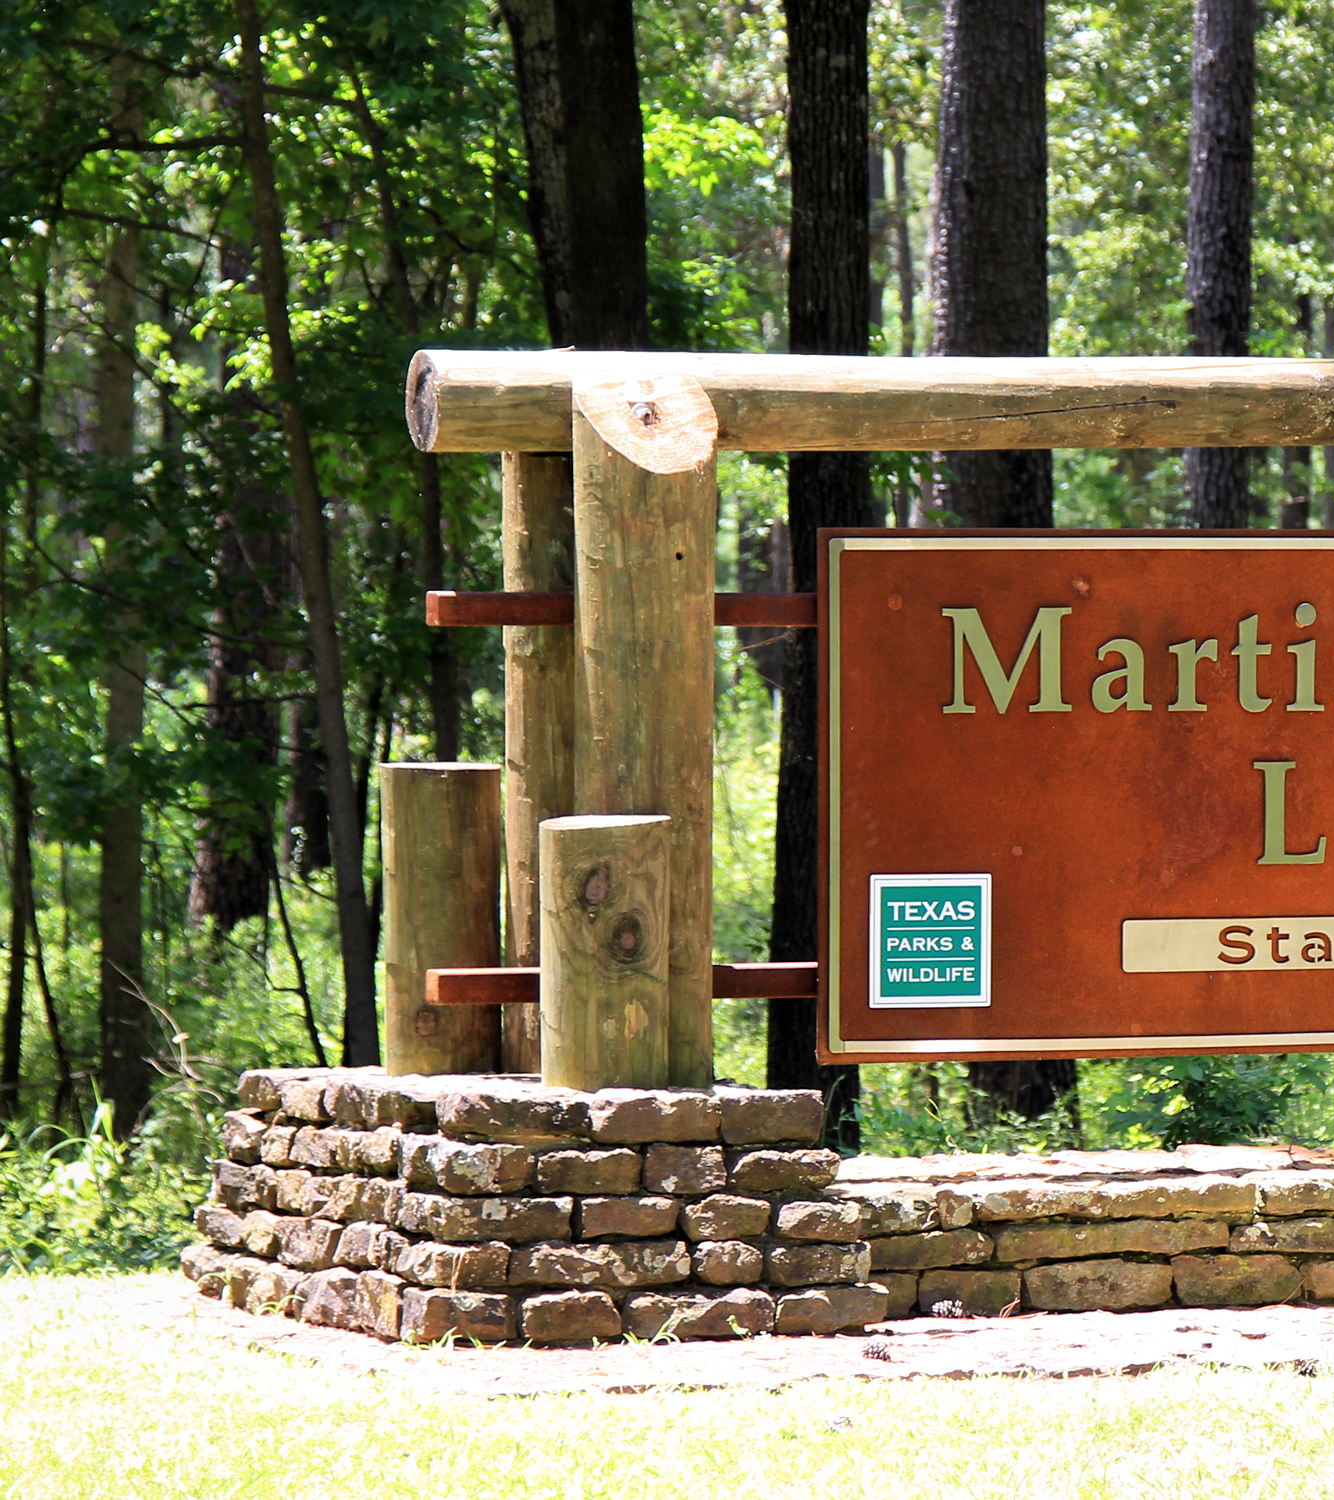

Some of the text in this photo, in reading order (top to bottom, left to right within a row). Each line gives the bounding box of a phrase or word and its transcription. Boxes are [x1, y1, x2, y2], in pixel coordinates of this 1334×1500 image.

[886, 900, 976, 921] TEXAS
[886, 936, 975, 952] PARKS &
[886, 966, 976, 983] WILDLIFE
